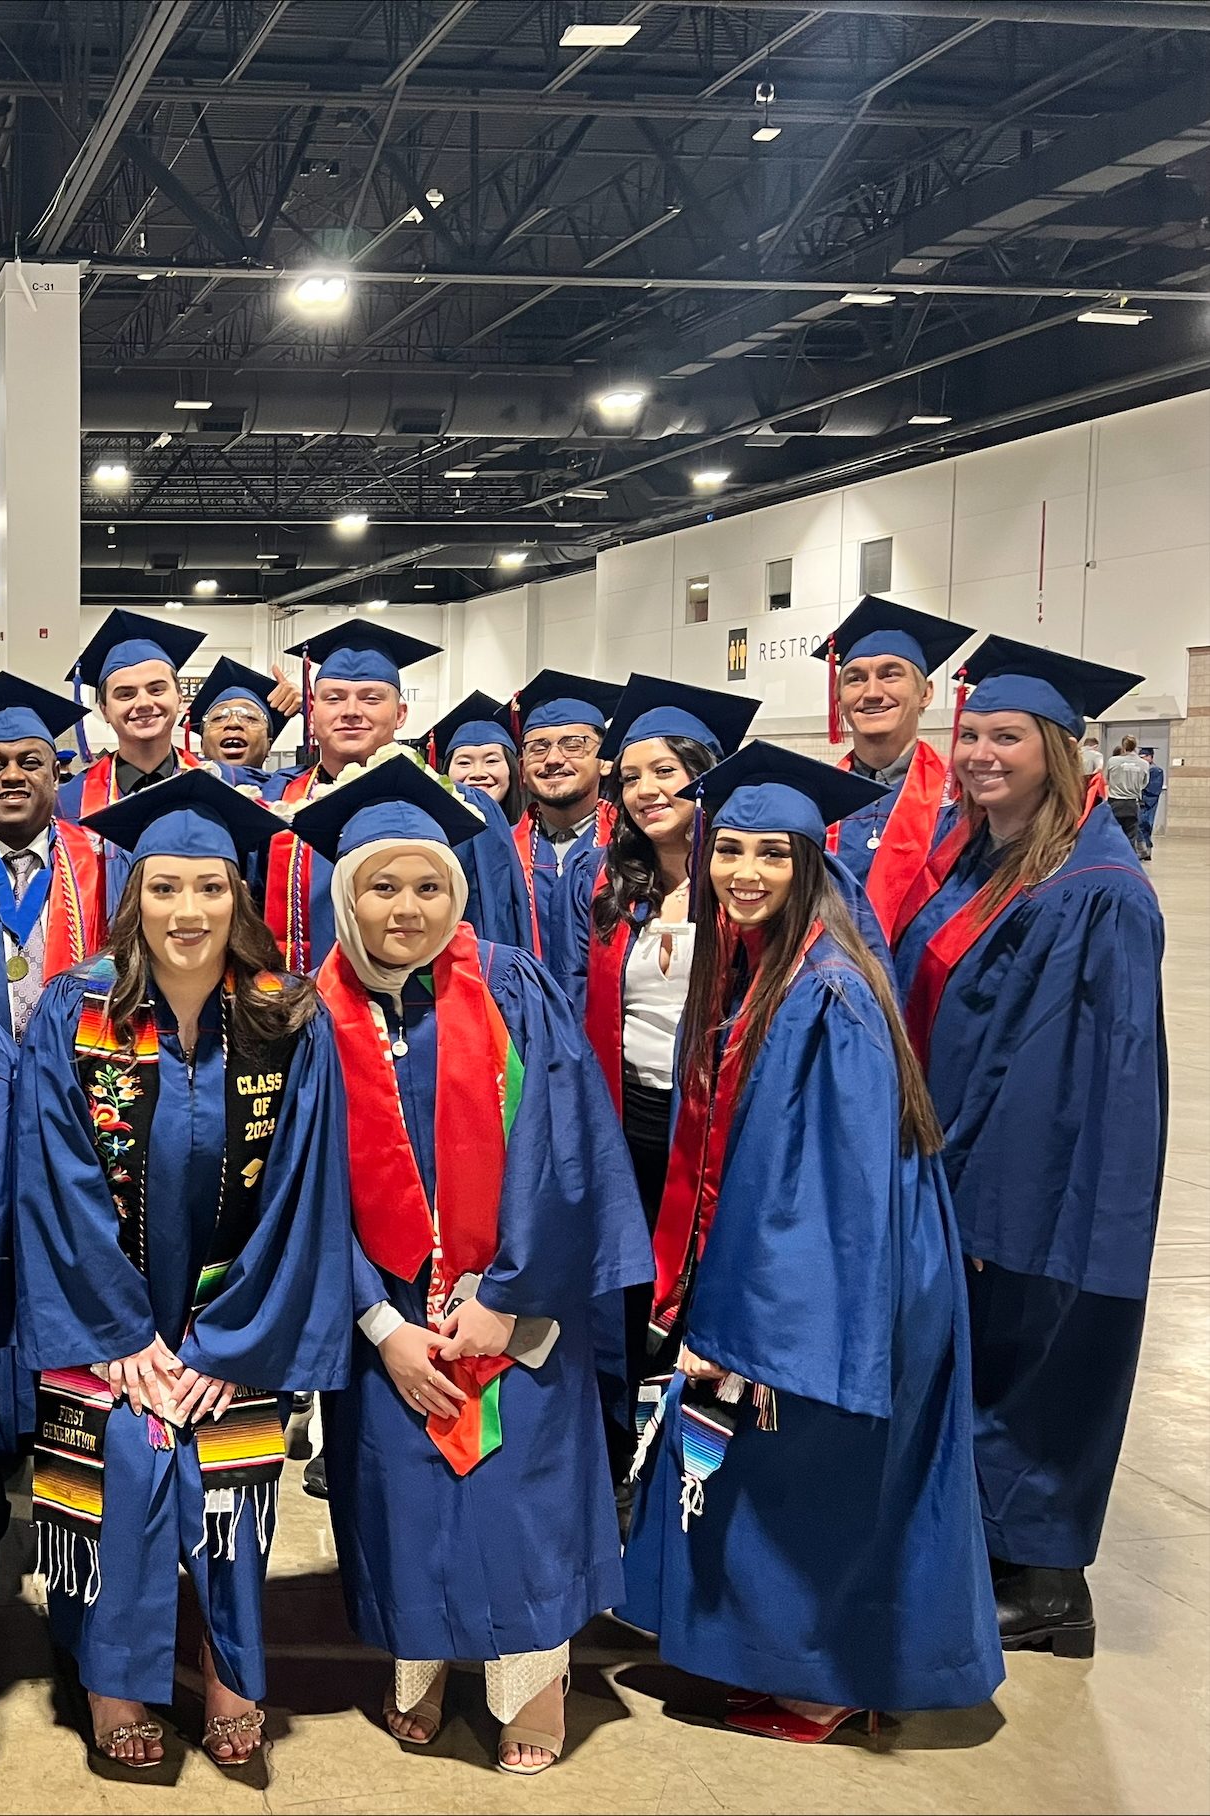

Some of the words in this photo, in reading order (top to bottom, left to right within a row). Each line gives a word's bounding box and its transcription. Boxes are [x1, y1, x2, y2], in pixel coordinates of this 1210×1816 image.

[32, 282, 54, 291] C-31
[236, 1072, 283, 1096] CLASS
[252, 1096, 272, 1117] OF
[244, 1117, 276, 1142] 2024
[58, 1404, 85, 1427] FIRST
[42, 1422, 97, 1452] GENERATION
